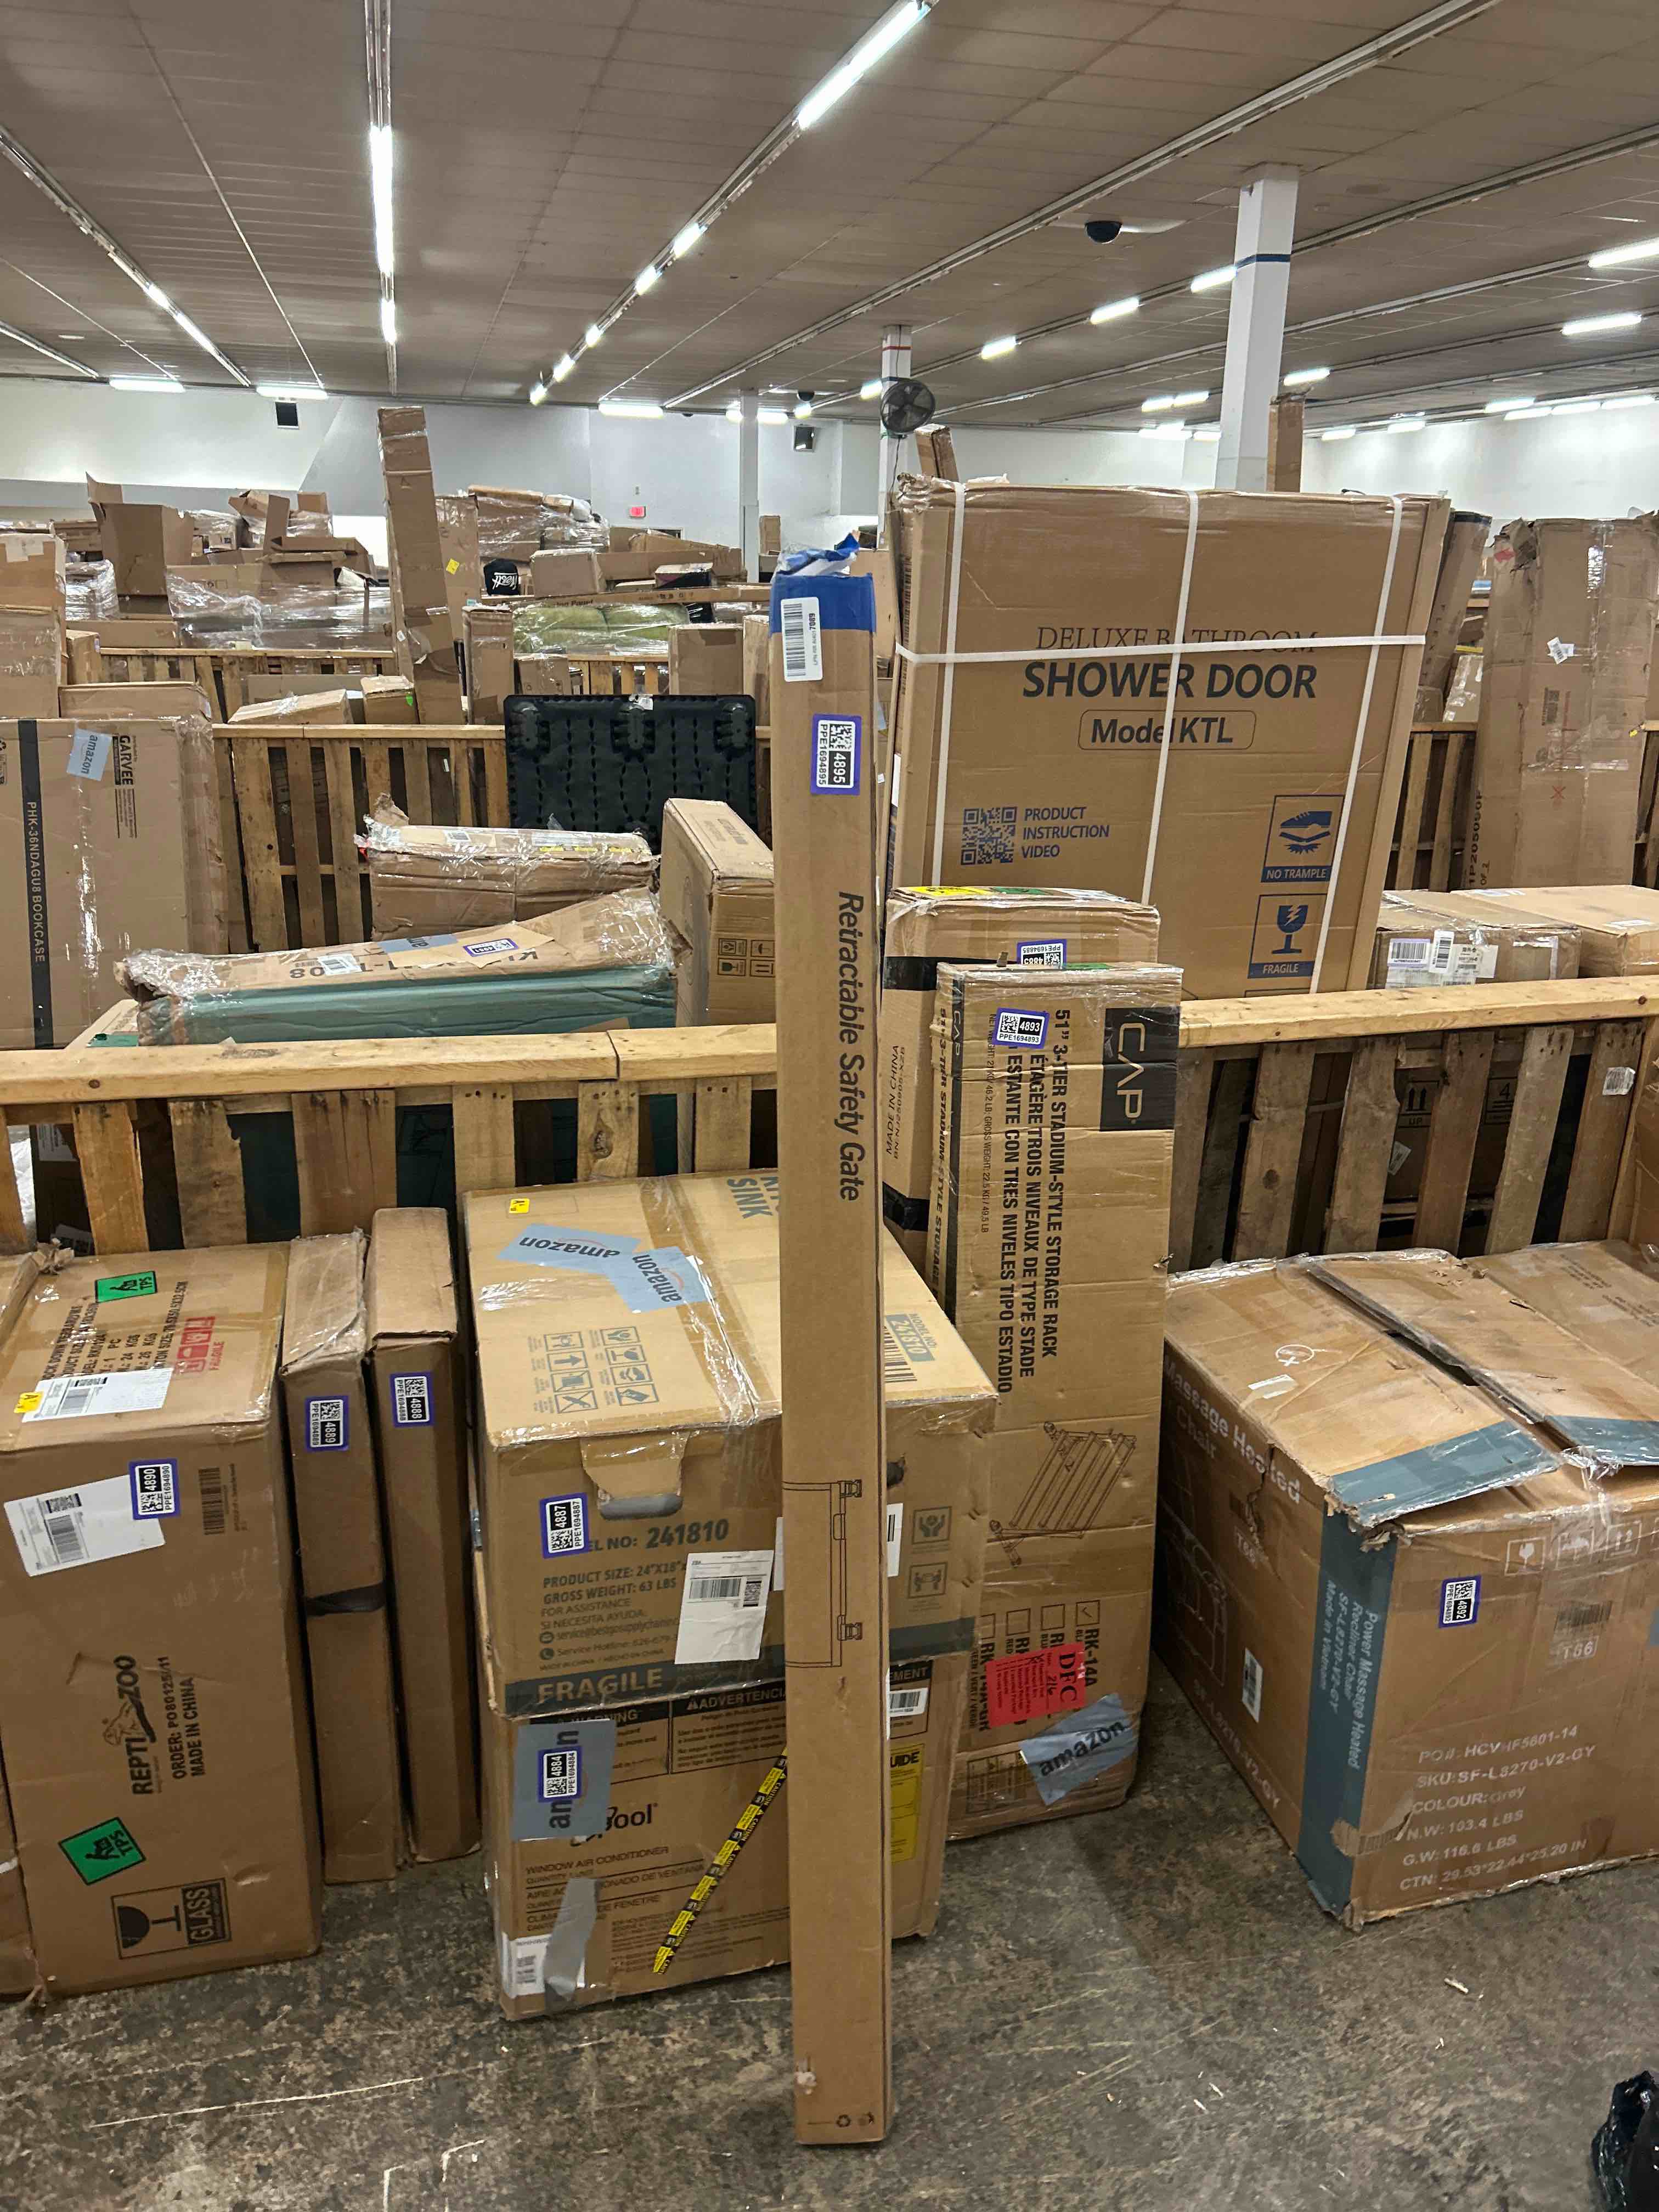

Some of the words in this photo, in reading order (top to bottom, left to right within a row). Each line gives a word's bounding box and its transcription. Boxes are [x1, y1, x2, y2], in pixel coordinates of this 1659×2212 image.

[1156, 628, 1318, 653] BTHROOM
[1023, 661, 1195, 697] SHOWER
[1206, 663, 1317, 698] DOOR
[1091, 718, 1173, 744] Model
[1179, 716, 1234, 743] KTL
[81, 735, 99, 775] amazon
[119, 735, 134, 786] GARVEE
[818, 724, 828, 786] PPE1694895
[833, 752, 846, 784] 4895
[1022, 825, 1110, 840] INSTRUCTION
[1024, 806, 1087, 821] PRODUCT
[1021, 845, 1060, 859] VIDEO
[1266, 870, 1282, 879] NO
[1285, 868, 1327, 878] TRAMPLE
[32, 895, 45, 962] BOOKCASE
[838, 891, 865, 1045] Retractable
[1262, 963, 1299, 974] FRAGILE
[999, 1033, 1040, 1043] PPE1694893
[1019, 1021, 1040, 1032] 4893
[890, 1046, 899, 1090] CHINA
[1052, 1045, 1068, 1097] 3-TIER
[1115, 1022, 1146, 1124] CAP
[833, 1053, 865, 1135] Safety
[888, 1093, 895, 1111] IN
[1005, 1056, 1023, 1125] ESTANTE
[1028, 1054, 1048, 1125] ÉTAGÈRE
[1004, 1130, 1020, 1164] CON
[1026, 1128, 1042, 1177] TROIS
[1047, 1102, 1067, 1232] STADIUM-STYLE
[839, 1143, 865, 1201] Gate
[1003, 1166, 1019, 1209] TRES
[727, 1177, 774, 1219] SINK
[1024, 1182, 1041, 1252] NIVEAUX
[520, 1238, 620, 1258] amazon
[1000, 1214, 1018, 1280] NIVELES
[1022, 1256, 1038, 1278] DE
[632, 1254, 682, 1302] amazon
[1044, 1235, 1062, 1310] STORAGE
[998, 1284, 1015, 1321] TIPO
[1020, 1281, 1037, 1322] TYPE
[1019, 1327, 1035, 1378] STADE
[1042, 1314, 1058, 1358] RACK
[997, 1327, 1014, 1393] ESTADIO
[410, 1397, 422, 1419] 4888
[324, 1421, 336, 1443] 4889
[143, 1468, 157, 1491] 4890
[162, 1465, 172, 1510] PPE1694890
[554, 1505, 567, 1529] 4887
[572, 1500, 581, 1547] PPE1694887
[607, 1535, 638, 1550] NO:
[645, 1518, 730, 1550] 241810
[544, 1571, 602, 1588] PRODUCT
[605, 1568, 633, 1581] SIZE:
[544, 1590, 583, 1605] GROSS
[586, 1583, 636, 1600] WEIGHT:
[639, 1581, 653, 1592] 63
[656, 1577, 677, 1590] LBS
[541, 1607, 563, 1617] FOR
[566, 1598, 631, 1613] ASSISTANCE
[1325, 1580, 1337, 1618] Made
[1456, 1600, 1468, 1620] 4892
[1348, 1601, 1364, 1661] Recliner
[1361, 1610, 1379, 1656] Power
[114, 1654, 140, 1700] ZOO
[538, 1668, 663, 1704] FRAGILE
[1352, 1657, 1373, 1719] Massage
[179, 1677, 199, 1721] CHINA
[699, 1688, 786, 1710] ADVERTENCI
[185, 1723, 200, 1737] IN
[1040, 1720, 1125, 1775] amazon
[1347, 1720, 1366, 1770] Heated
[125, 1736, 154, 1796] REPTI
[168, 1732, 187, 1780] ORDER:
[187, 1739, 206, 1778] MADE
[550, 1756, 562, 1776] 4884
[765, 1782, 782, 1806] CAUTION
[1492, 1809, 1525, 1827] LBS
[526, 1863, 574, 1874] WINDOW
[575, 1859, 595, 1867] AIR
[596, 1846, 669, 1865] CONDITIONER
[1487, 1833, 1518, 1852] LBS
[183, 1887, 212, 1942] GLASS
